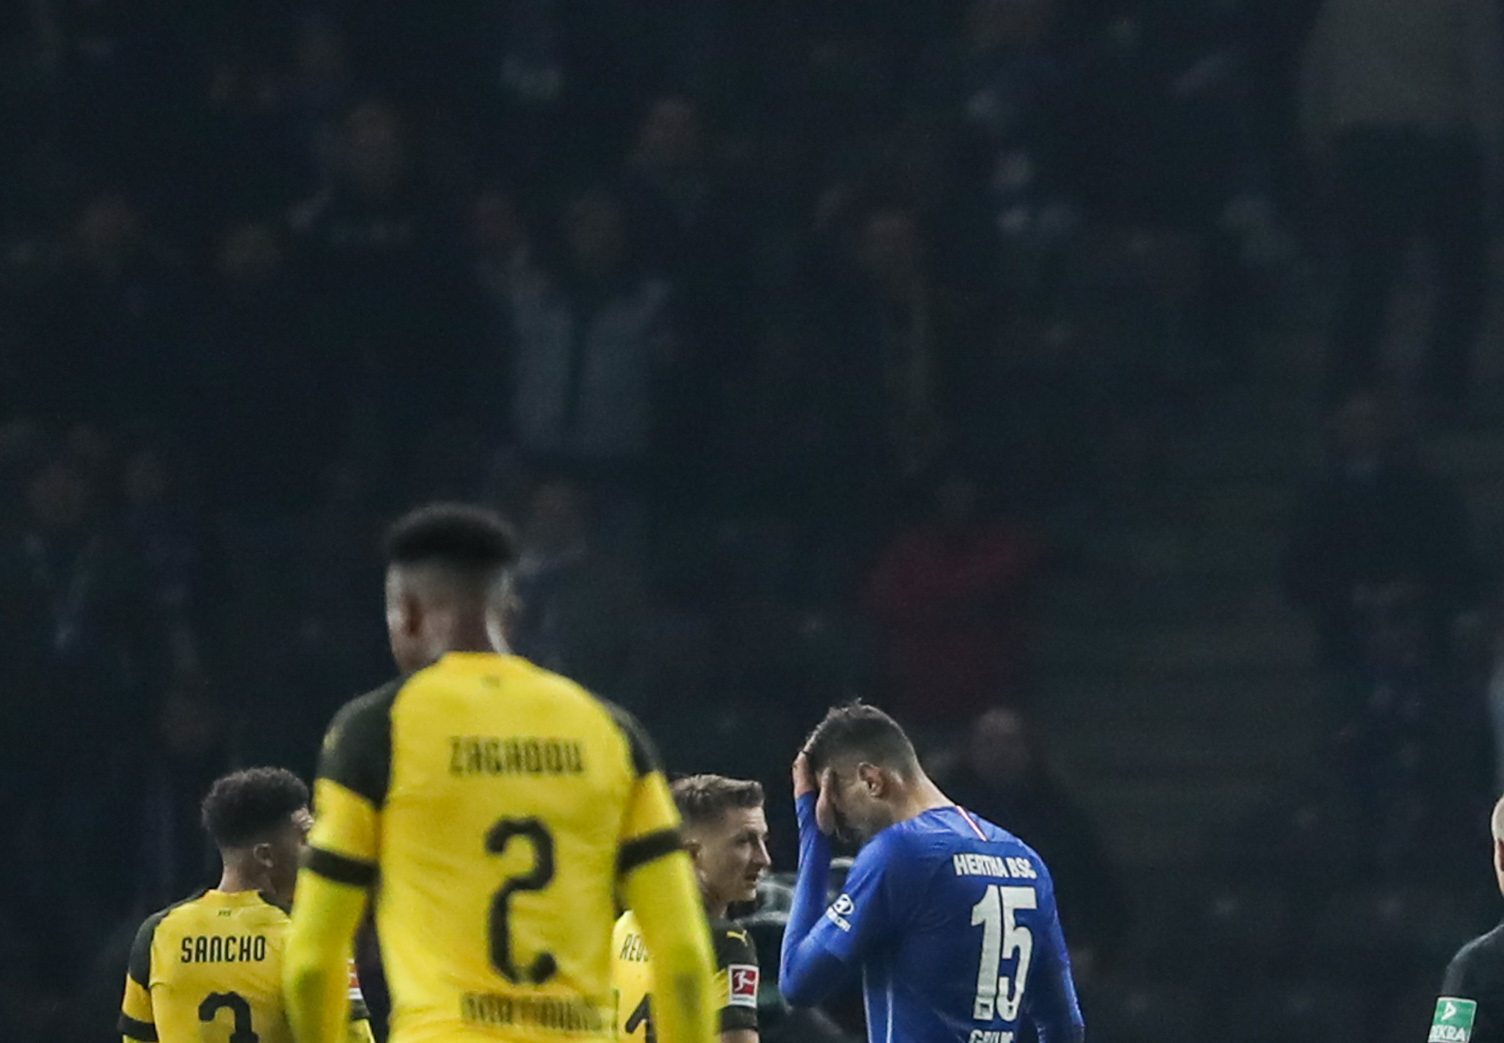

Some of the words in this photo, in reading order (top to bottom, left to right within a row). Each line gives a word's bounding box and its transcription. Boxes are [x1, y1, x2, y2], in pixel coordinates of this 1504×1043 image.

[953, 853, 1010, 878] HERTHA
[484, 816, 556, 984] 2
[181, 936, 266, 963] SANCHO
[620, 933, 648, 962] REU
[971, 884, 1038, 1022] 15
